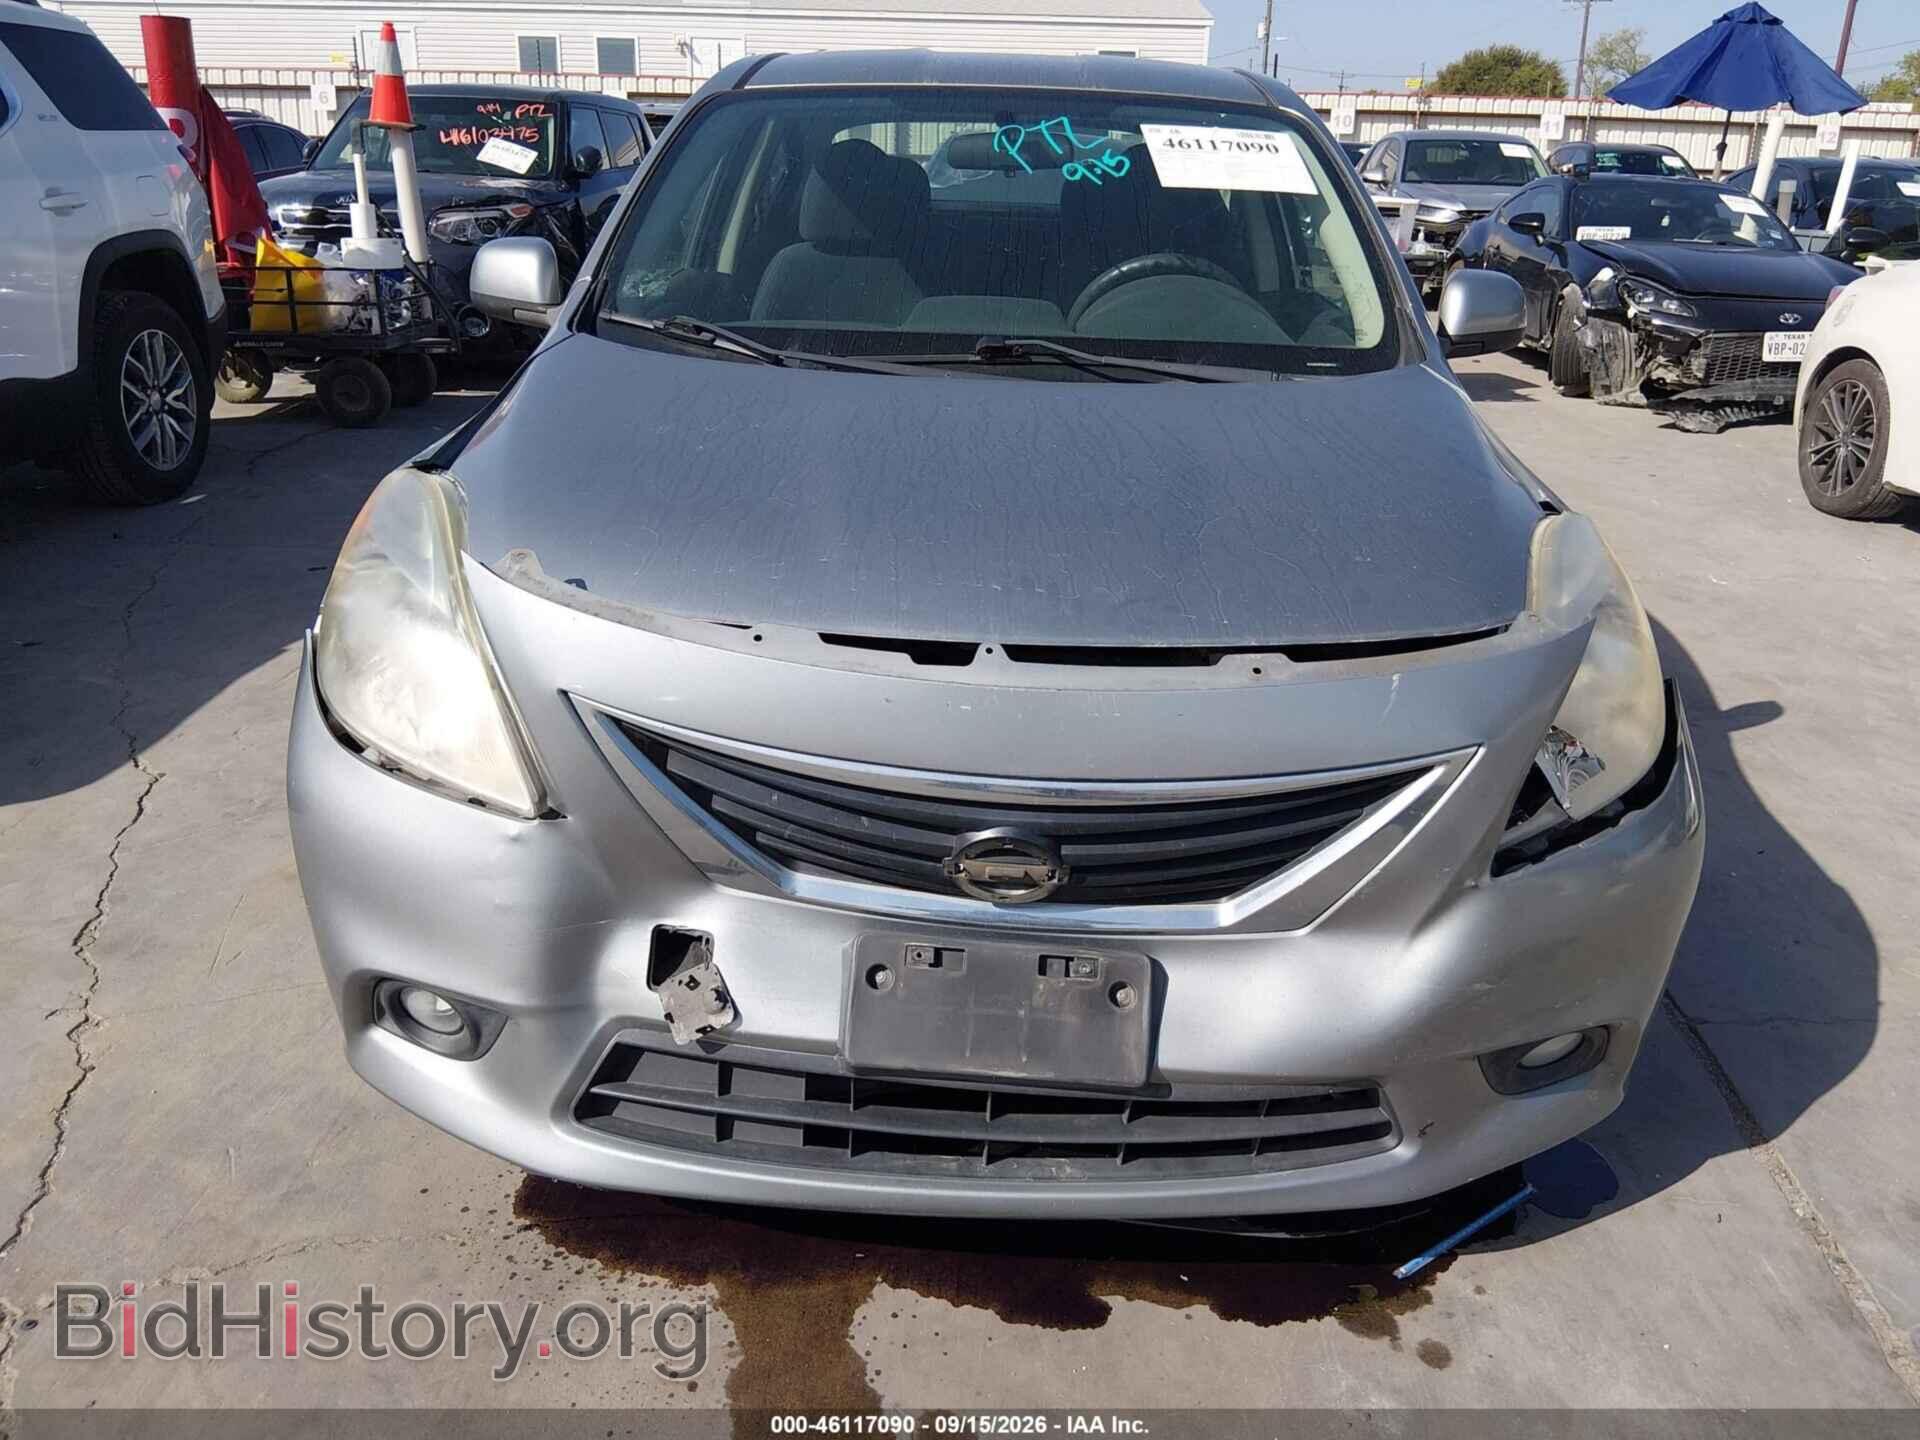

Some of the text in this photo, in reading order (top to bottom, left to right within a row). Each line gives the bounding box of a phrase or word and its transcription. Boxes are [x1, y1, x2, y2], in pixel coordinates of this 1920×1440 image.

[1334, 114, 1353, 128] 10
[1543, 120, 1561, 133] 11
[1162, 137, 1280, 155] 46117090
